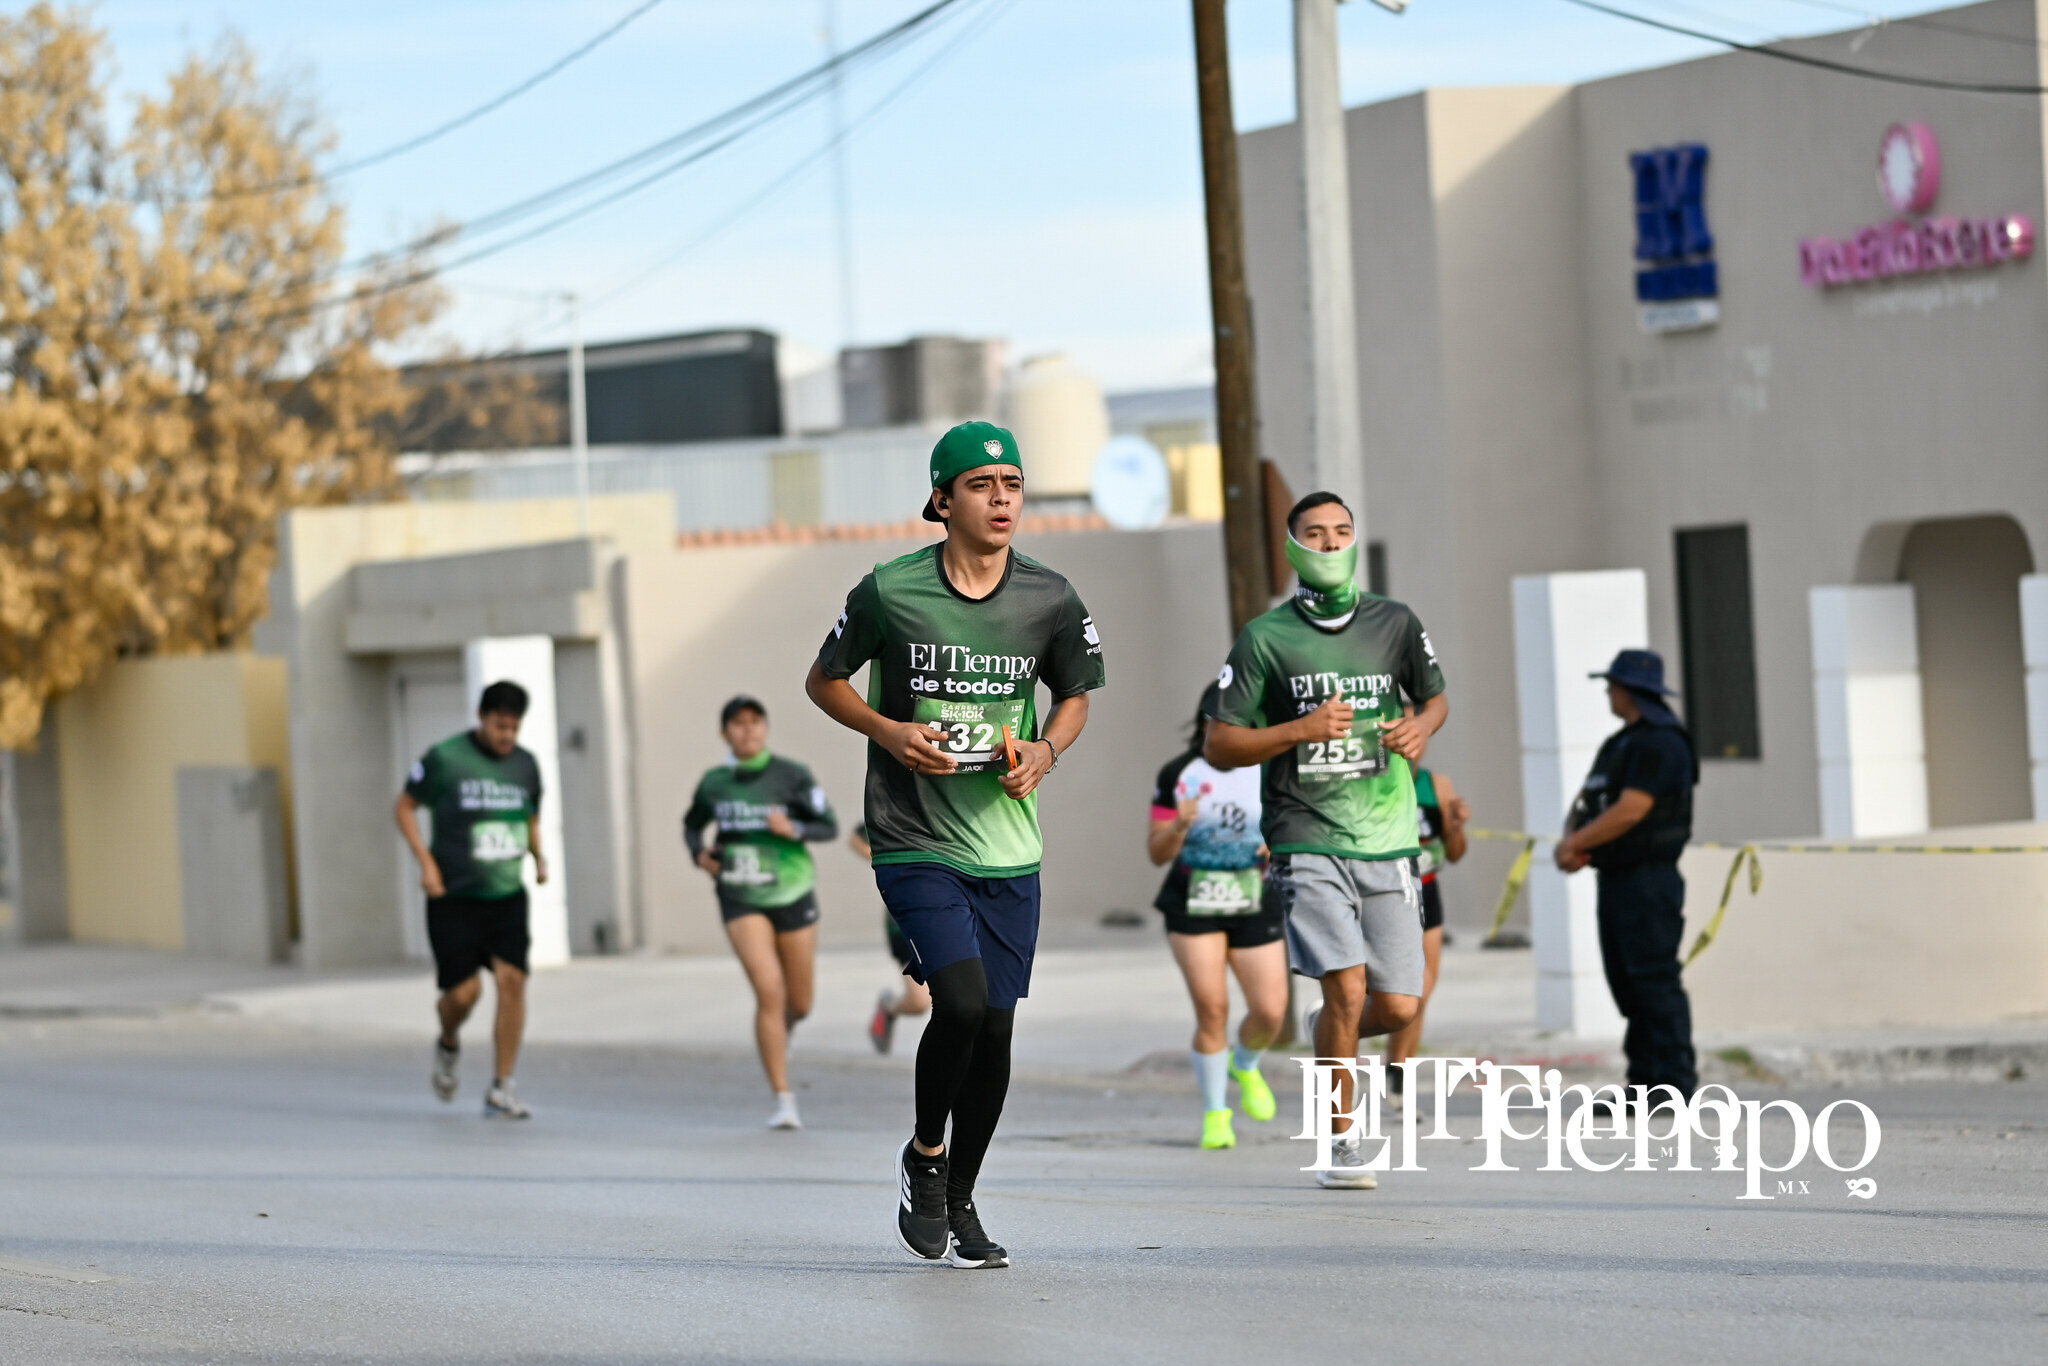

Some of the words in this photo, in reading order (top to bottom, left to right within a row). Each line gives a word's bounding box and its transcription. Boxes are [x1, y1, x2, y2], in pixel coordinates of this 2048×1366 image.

[908, 643, 937, 672] El
[942, 645, 1036, 681] Tiempo
[910, 675, 940, 693] de
[943, 678, 1016, 695] todos
[1290, 674, 1314, 698] El
[1315, 672, 1392, 696] Tiempo
[941, 703, 985, 711] CARRERA
[928, 720, 994, 752] 132
[1308, 738, 1364, 764] 255
[1198, 881, 1244, 901] 306
